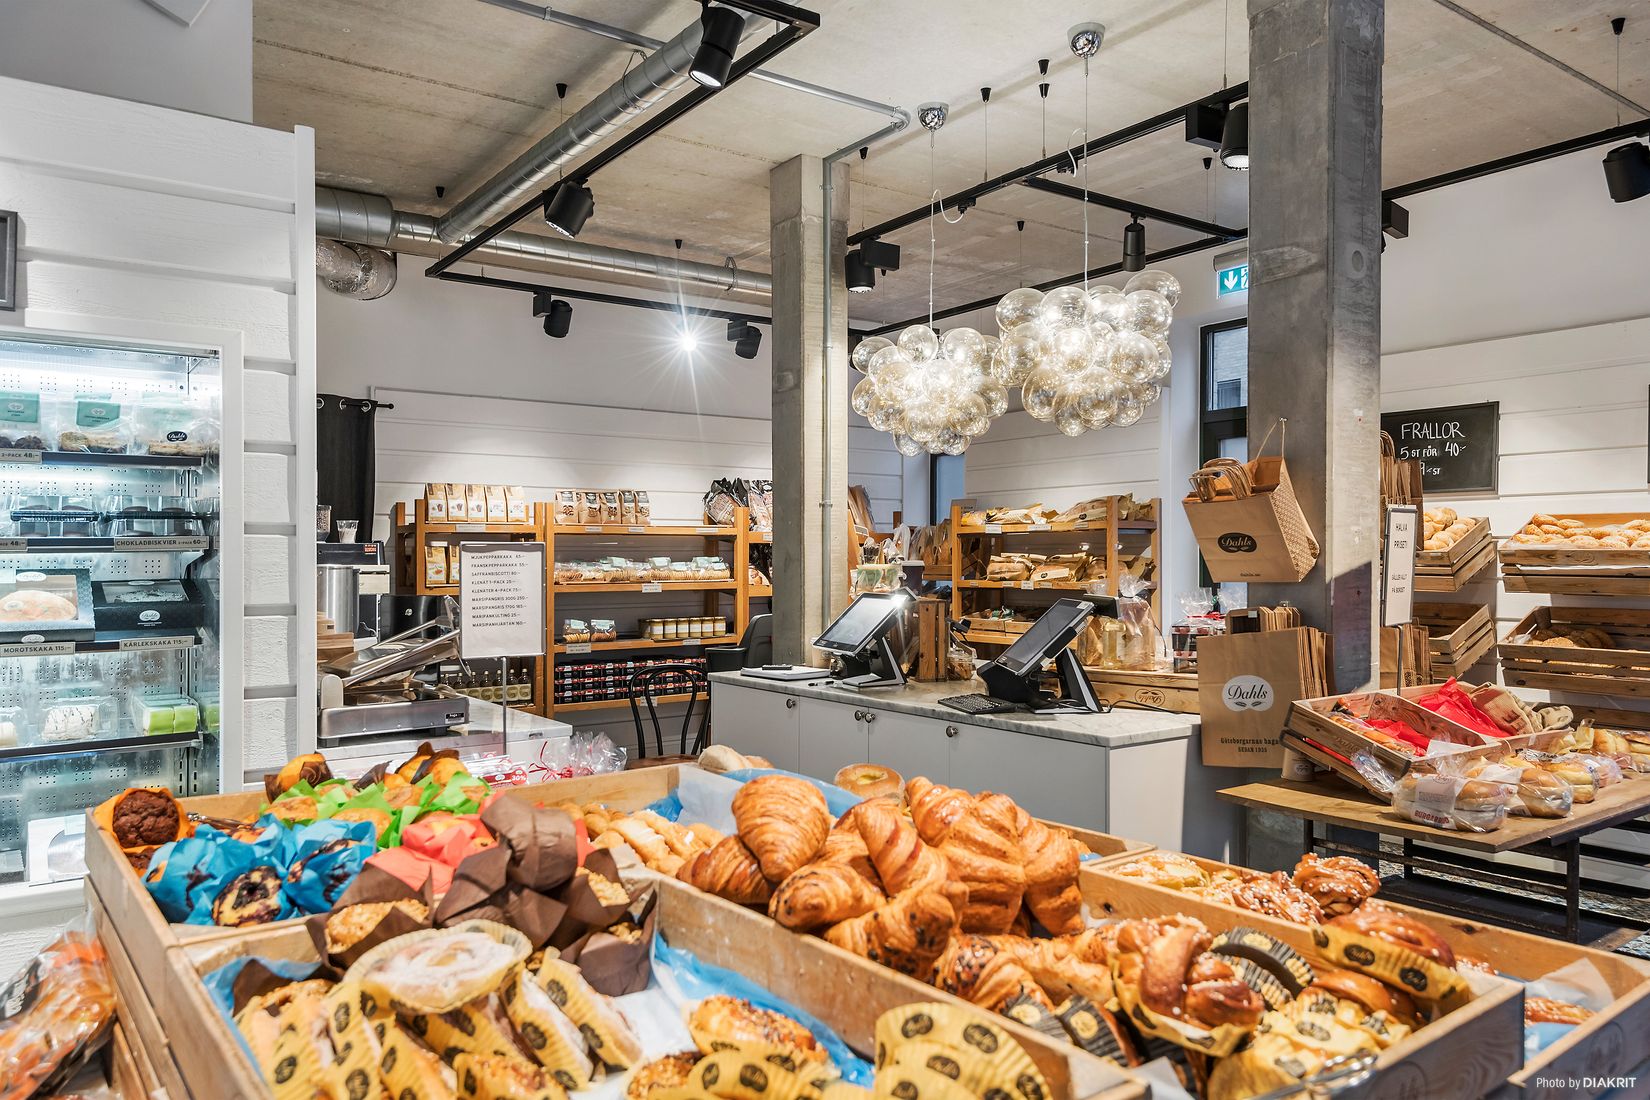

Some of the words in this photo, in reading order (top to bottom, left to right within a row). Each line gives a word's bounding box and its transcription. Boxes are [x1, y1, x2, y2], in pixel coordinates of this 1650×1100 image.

[1401, 421, 1466, 440] FRALLOR
[1400, 446, 1409, 460] 5
[1411, 448, 1420, 458] ST
[1422, 445, 1438, 457] FÖR
[1221, 536, 1252, 547] Dahls
[1227, 684, 1268, 700] Dahls
